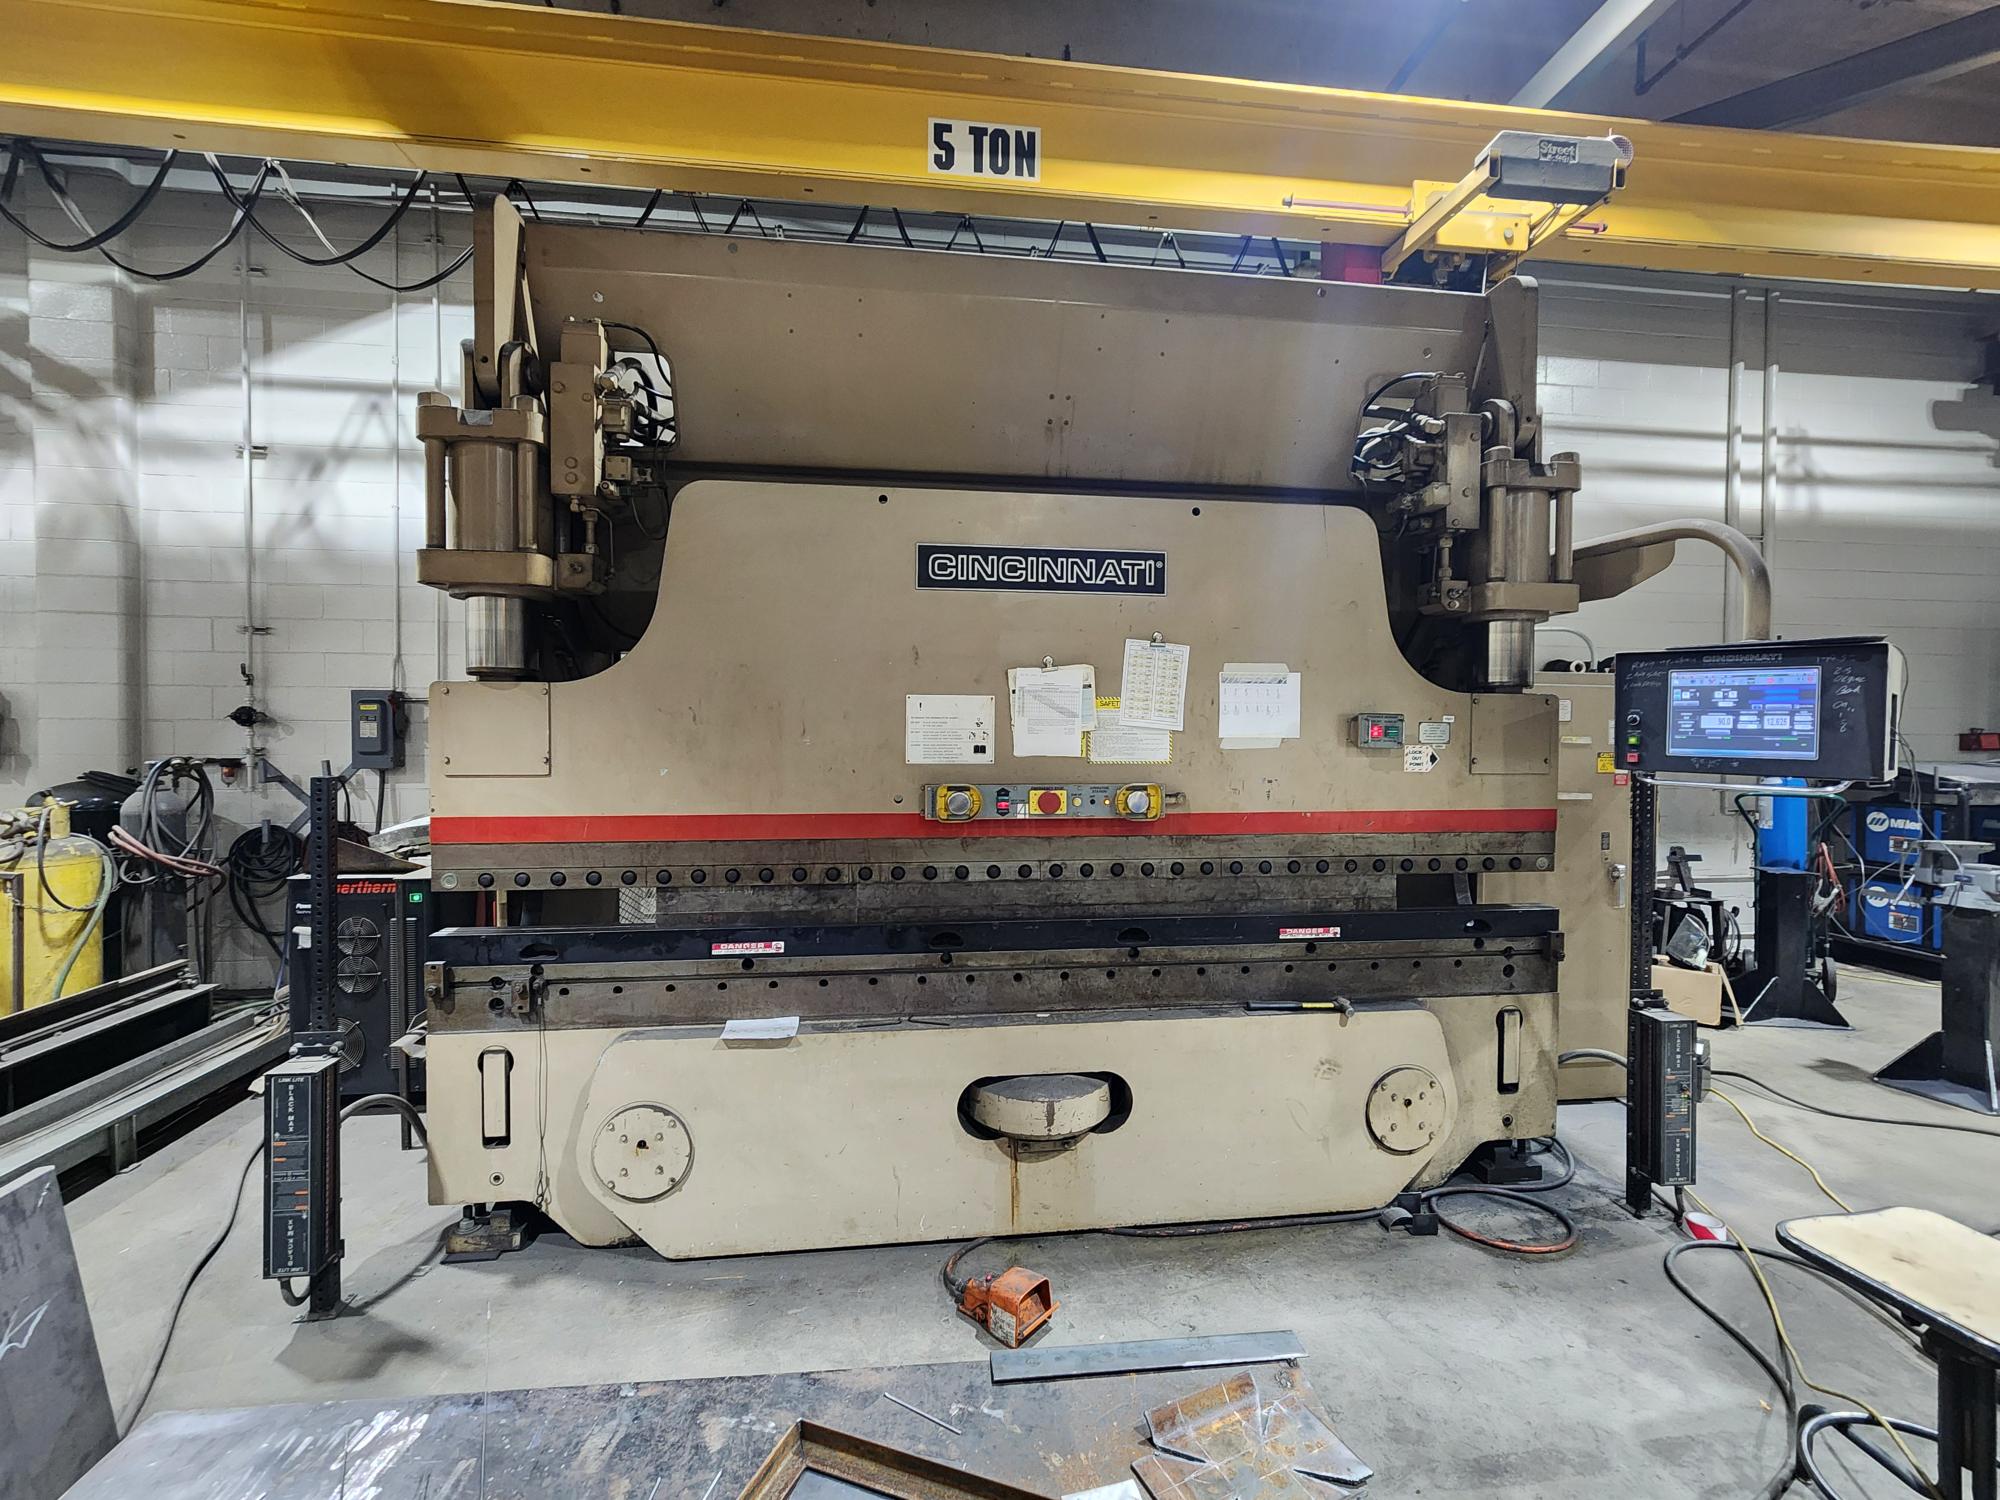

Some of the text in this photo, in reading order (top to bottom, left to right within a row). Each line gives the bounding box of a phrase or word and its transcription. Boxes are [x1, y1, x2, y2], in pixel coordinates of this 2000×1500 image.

[933, 122, 1036, 178] 5 TON
[720, 942, 765, 950] DANGER
